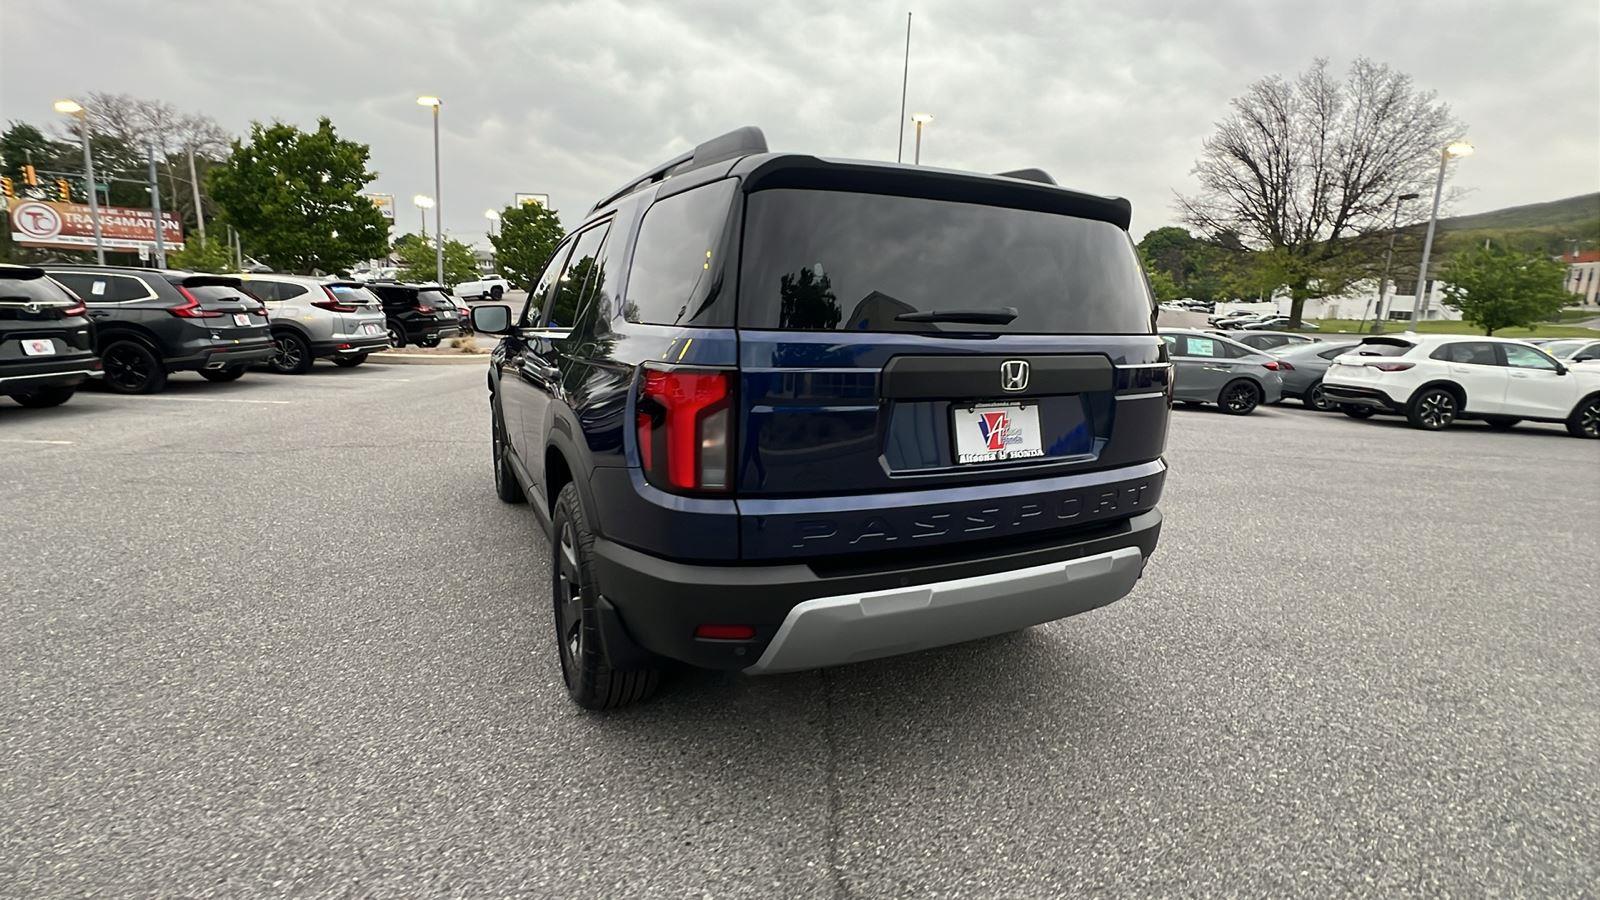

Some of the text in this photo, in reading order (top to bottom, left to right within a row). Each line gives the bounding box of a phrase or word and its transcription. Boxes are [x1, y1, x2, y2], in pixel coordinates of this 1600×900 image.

[64, 212, 180, 230] TRANS4MATION
[1010, 448, 1045, 459] HONDA
[792, 485, 1150, 548] PASSPORT
